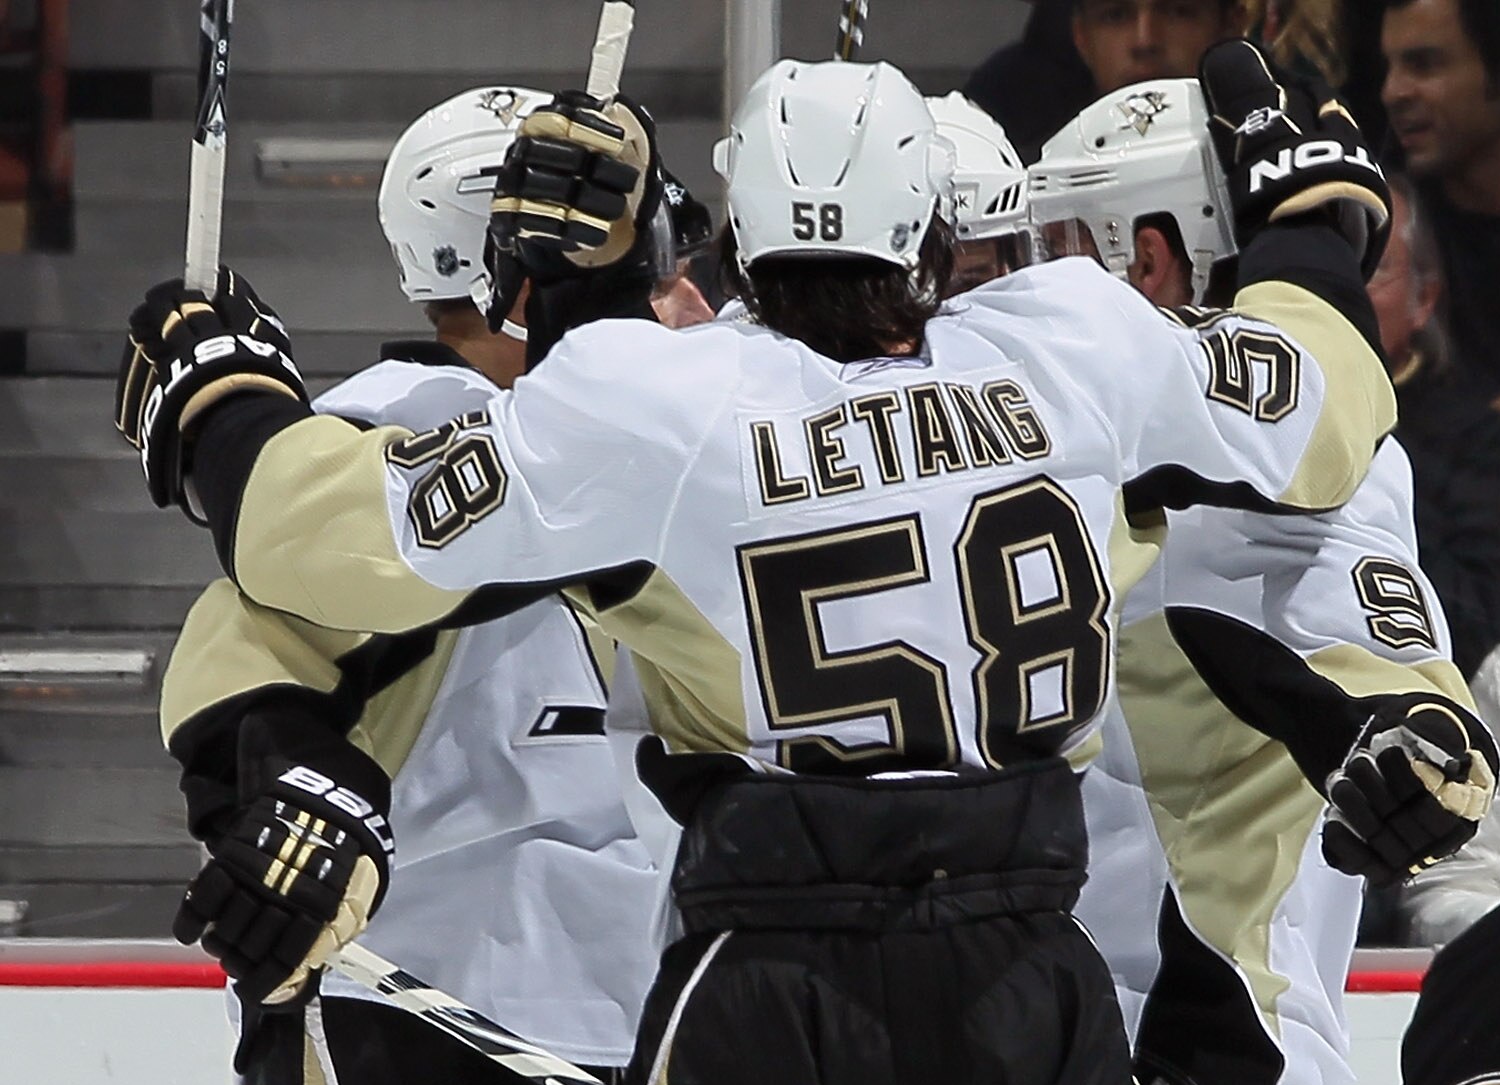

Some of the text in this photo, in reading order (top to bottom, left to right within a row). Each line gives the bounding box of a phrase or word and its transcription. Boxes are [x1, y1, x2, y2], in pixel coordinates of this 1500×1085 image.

[1249, 140, 1387, 193] TON
[791, 202, 843, 241] 58
[750, 378, 1052, 507] LETANG
[735, 473, 1112, 772] 58
[1350, 556, 1440, 653] 9
